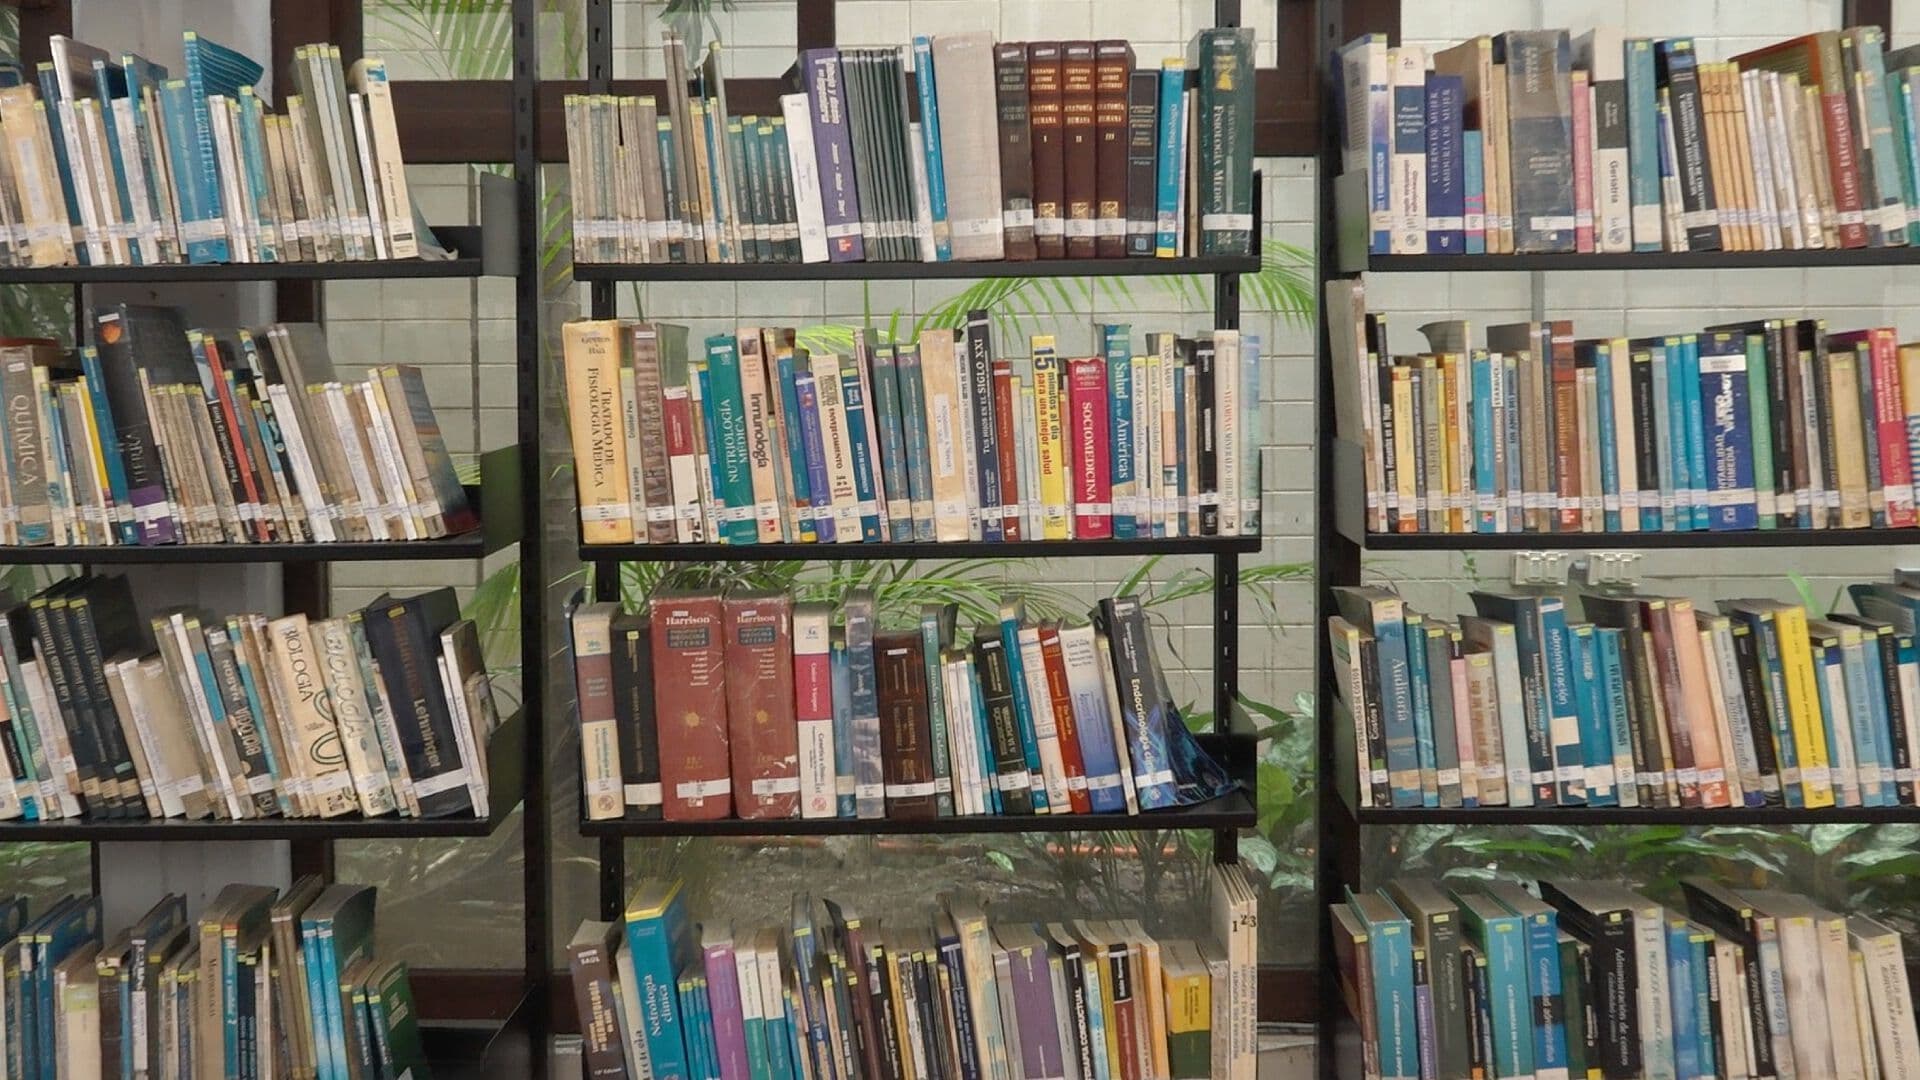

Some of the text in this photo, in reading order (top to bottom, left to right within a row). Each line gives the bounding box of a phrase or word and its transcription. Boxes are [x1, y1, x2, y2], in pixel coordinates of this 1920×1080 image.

[974, 338, 984, 358] XXI
[1034, 348, 1056, 370] 15
[976, 362, 988, 394] SIGLO
[1048, 372, 1060, 410] minutos
[750, 393, 769, 468] Inmunología
[1035, 373, 1052, 479] para una mejor salud
[1050, 418, 1058, 428] al
[1114, 363, 1130, 478] Salud Américas
[605, 449, 615, 465] DE
[719, 398, 738, 482] NUTRIOLOGÍA
[1082, 402, 1097, 505] SOCIOMEDICINA
[666, 616, 710, 625] Harrison
[737, 616, 776, 624] Harrison
[1552, 629, 1568, 704] administración
[1390, 658, 1406, 721] Auditoría
[413, 698, 442, 767] Lehninger
[1131, 678, 1151, 749] Endocrinología
[1370, 708, 1379, 739] Costos
[1233, 921, 1237, 932] 1
[1240, 915, 1248, 925] 2
[1249, 916, 1257, 927] 3
[1541, 958, 1552, 1006] Contabilidad
[1616, 948, 1628, 1020] Administración
[642, 974, 662, 1037] Nefrología
[658, 985, 672, 1022] clínica
[1075, 987, 1092, 1080] ERAPIA CONDUCTUAL
[1620, 1023, 1629, 1034] de
